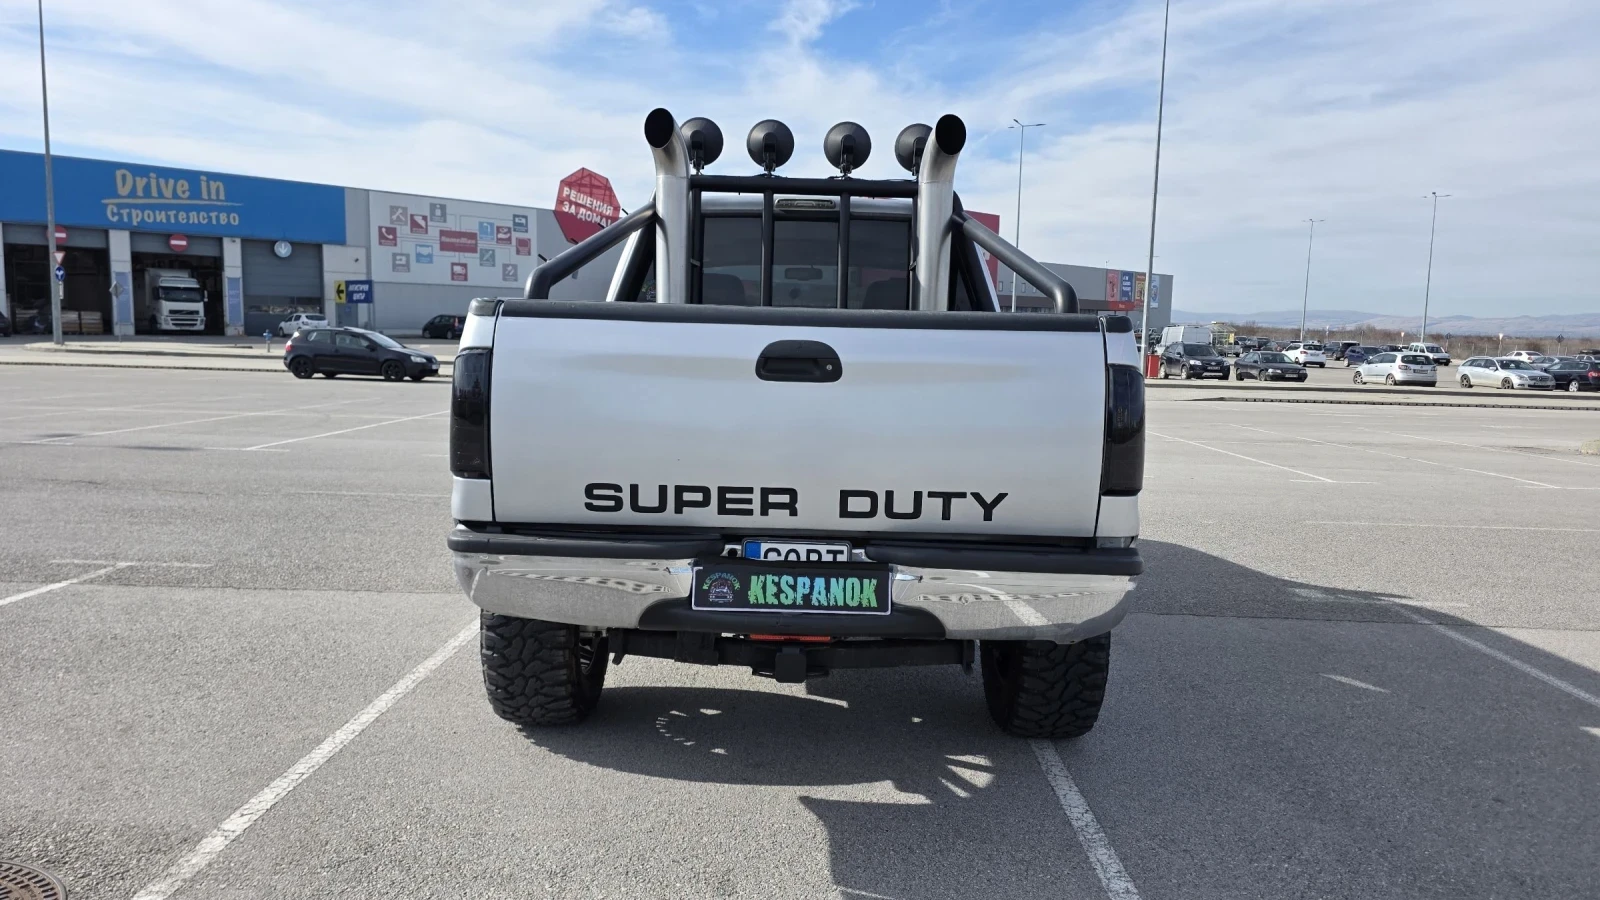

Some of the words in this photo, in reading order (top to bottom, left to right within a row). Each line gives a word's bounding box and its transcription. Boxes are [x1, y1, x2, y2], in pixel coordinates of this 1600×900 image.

[115, 168, 190, 199] Drive
[201, 175, 226, 200] in
[106, 204, 239, 226] Строителство
[562, 186, 614, 216] РЕШЕНИЯ
[562, 201, 577, 216] ЗА
[584, 483, 798, 516] SUPER
[839, 490, 1009, 521] DUTY
[702, 572, 740, 590] KESPANOK
[748, 574, 878, 608] KESPANOK
